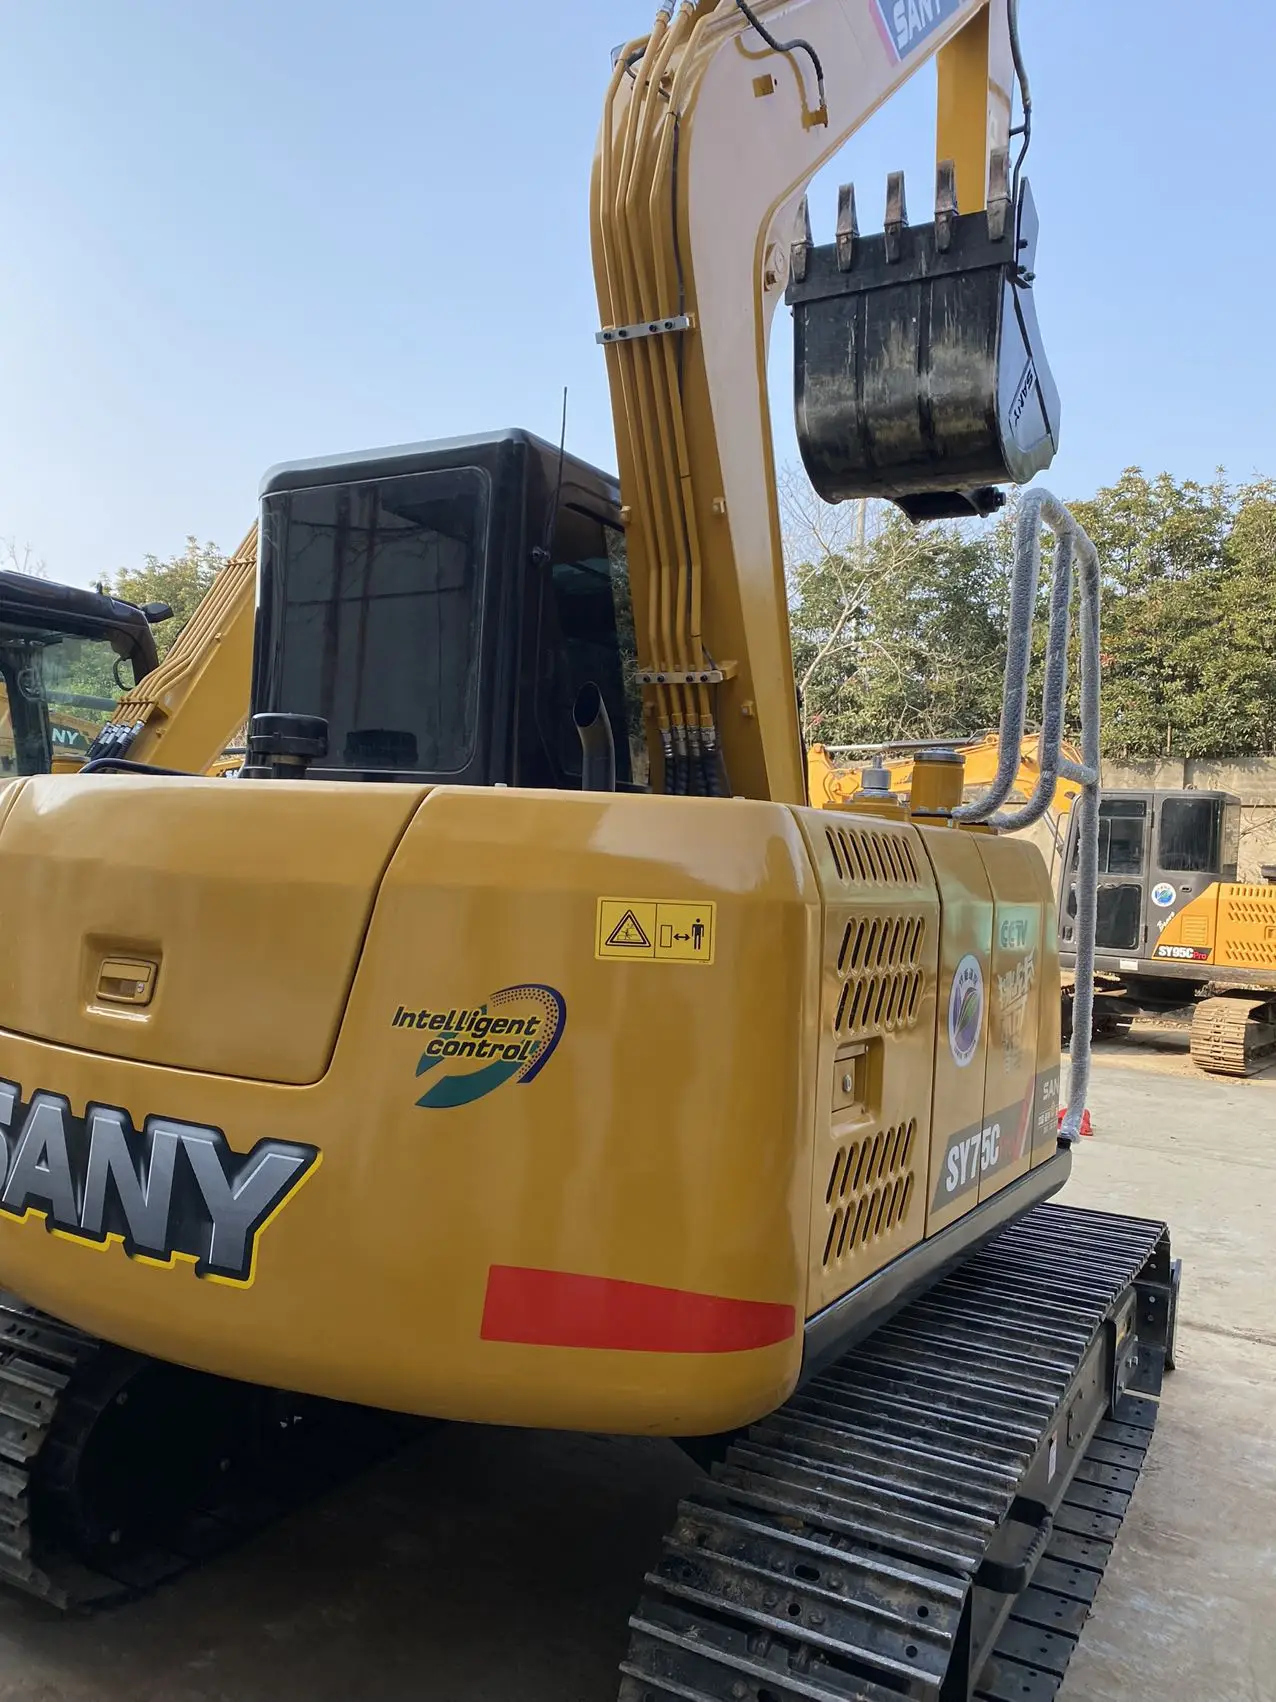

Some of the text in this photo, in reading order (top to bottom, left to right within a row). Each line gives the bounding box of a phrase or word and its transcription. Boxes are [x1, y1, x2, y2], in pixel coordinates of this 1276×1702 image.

[51, 727, 80, 745] NY
[1158, 945, 1207, 960] SY95C Pro
[392, 1006, 541, 1038] Intelligent
[426, 1038, 531, 1062] control
[1043, 1076, 1060, 1101] SAN
[946, 1123, 1001, 1192] SY75C
